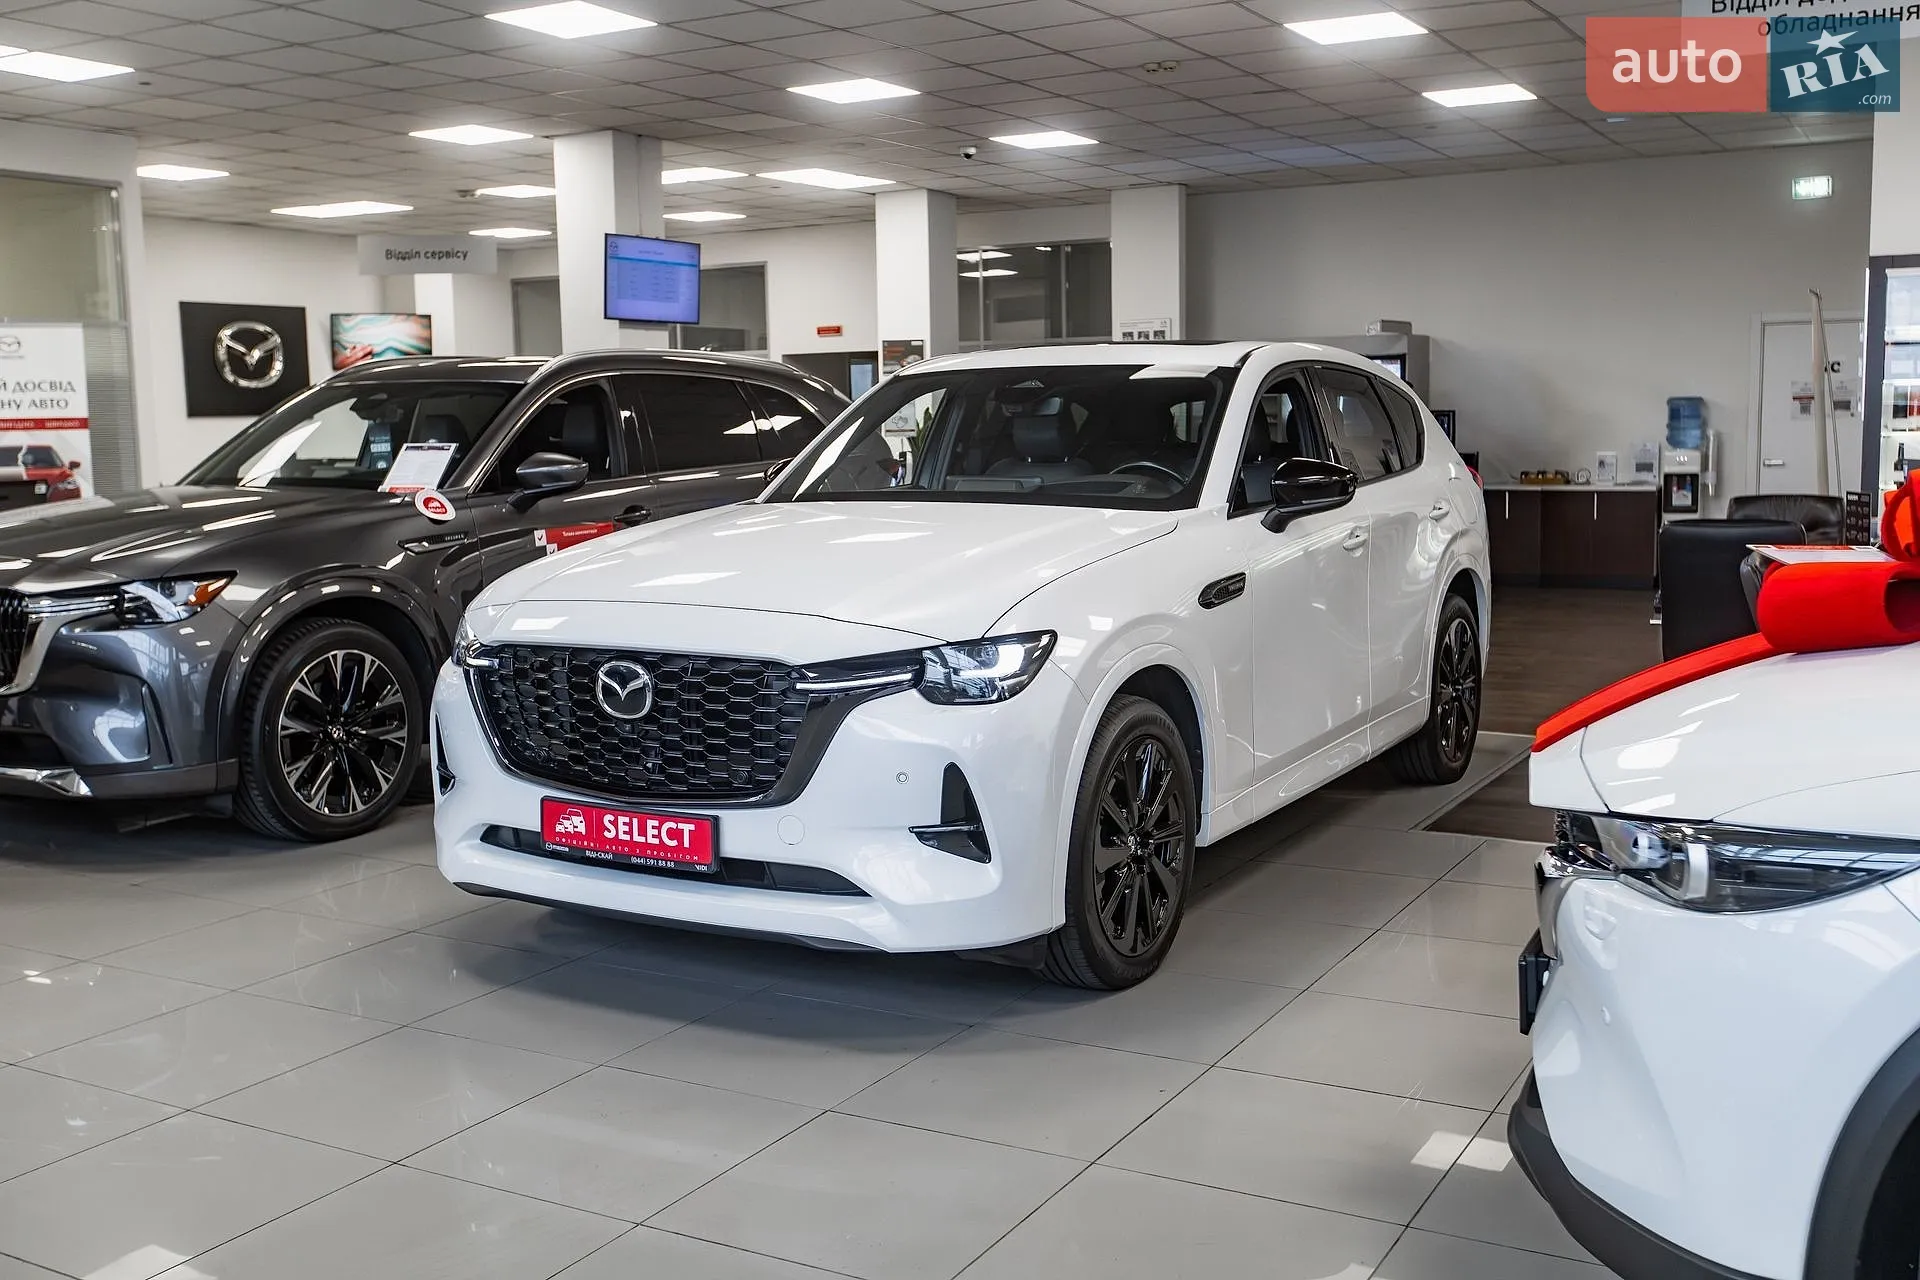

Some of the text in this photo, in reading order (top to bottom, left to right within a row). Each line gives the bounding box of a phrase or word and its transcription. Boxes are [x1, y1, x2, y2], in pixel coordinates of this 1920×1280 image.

[1758, 4, 1920, 37] обладнання
[385, 248, 468, 261] Відділ сервісу
[12, 380, 76, 394] ДОСВІД
[28, 399, 69, 410] АВТО
[603, 814, 695, 848] SELECT
[605, 844, 629, 853] АВТО
[646, 850, 699, 861] ПРОБІГОМ
[631, 856, 646, 865] (044)
[647, 858, 657, 866] 591
